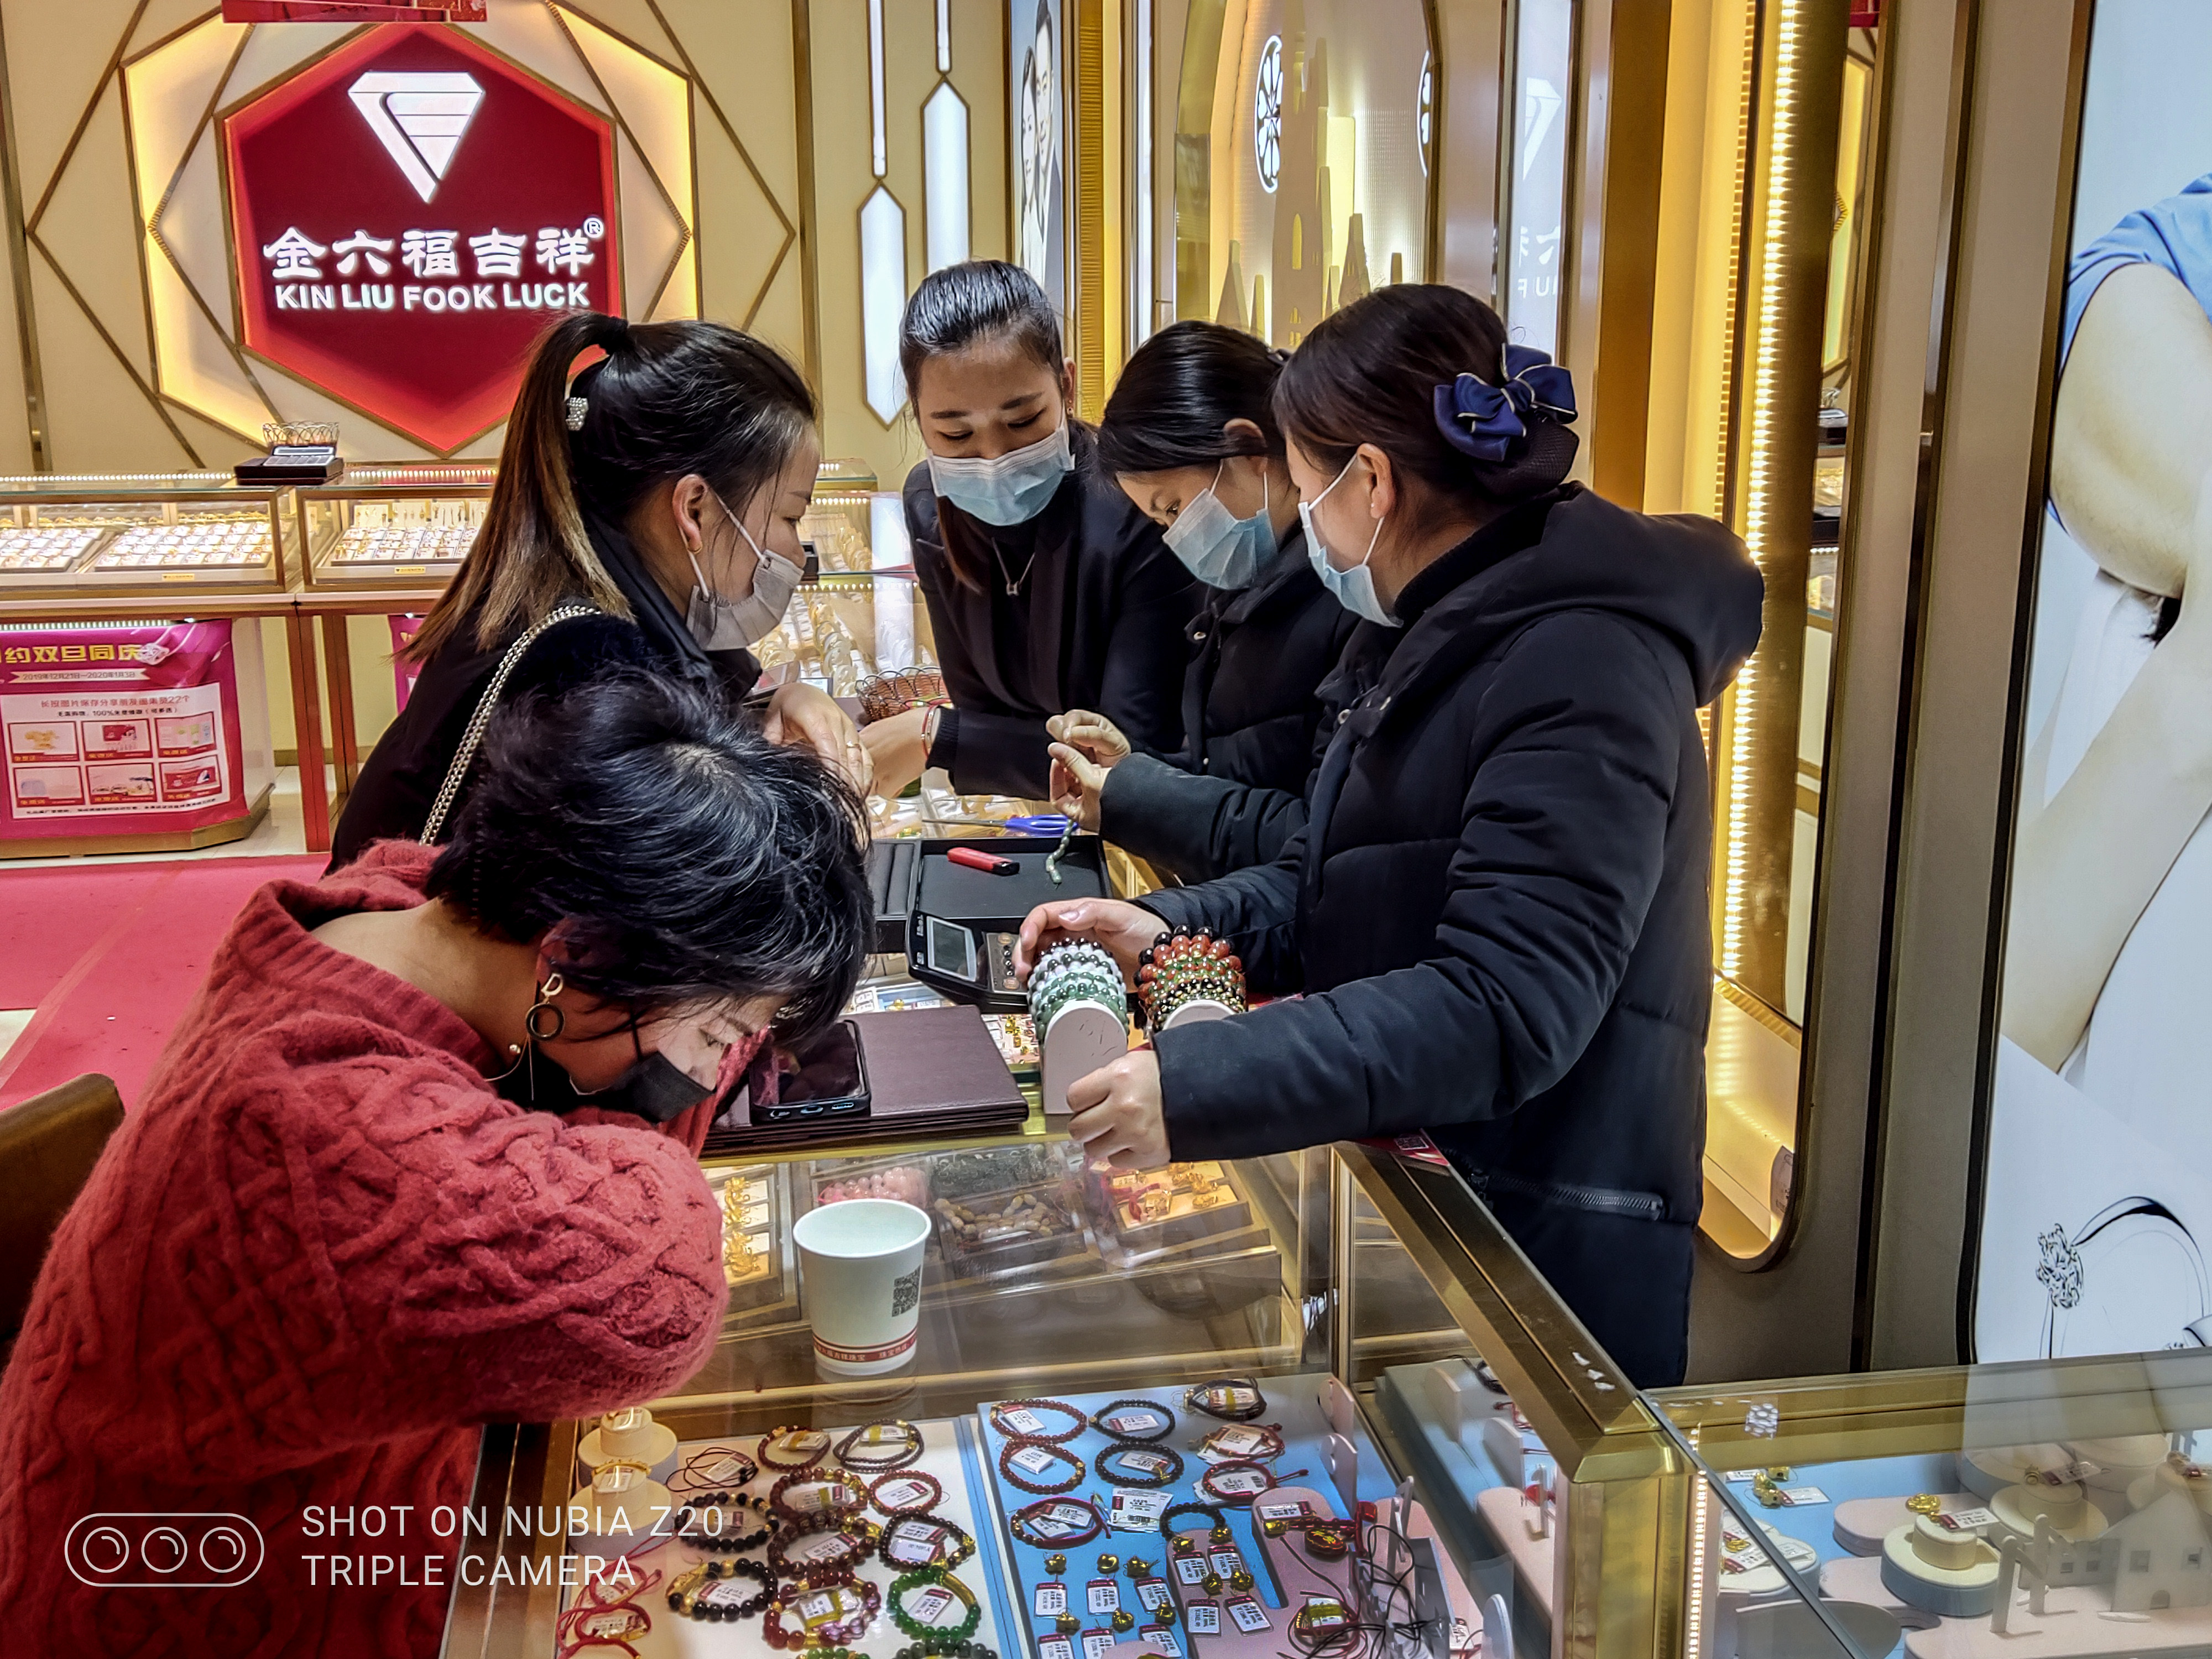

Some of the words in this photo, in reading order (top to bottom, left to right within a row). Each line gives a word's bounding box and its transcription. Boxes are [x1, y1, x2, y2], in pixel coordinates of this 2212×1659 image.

[262, 226, 594, 280] 金六福吉祥
[274, 284, 336, 310] KIN
[341, 283, 395, 310] LIU
[403, 284, 498, 312] FOOK
[502, 281, 591, 310] LUCK
[0, 644, 143, 664] 约双旦同庆
